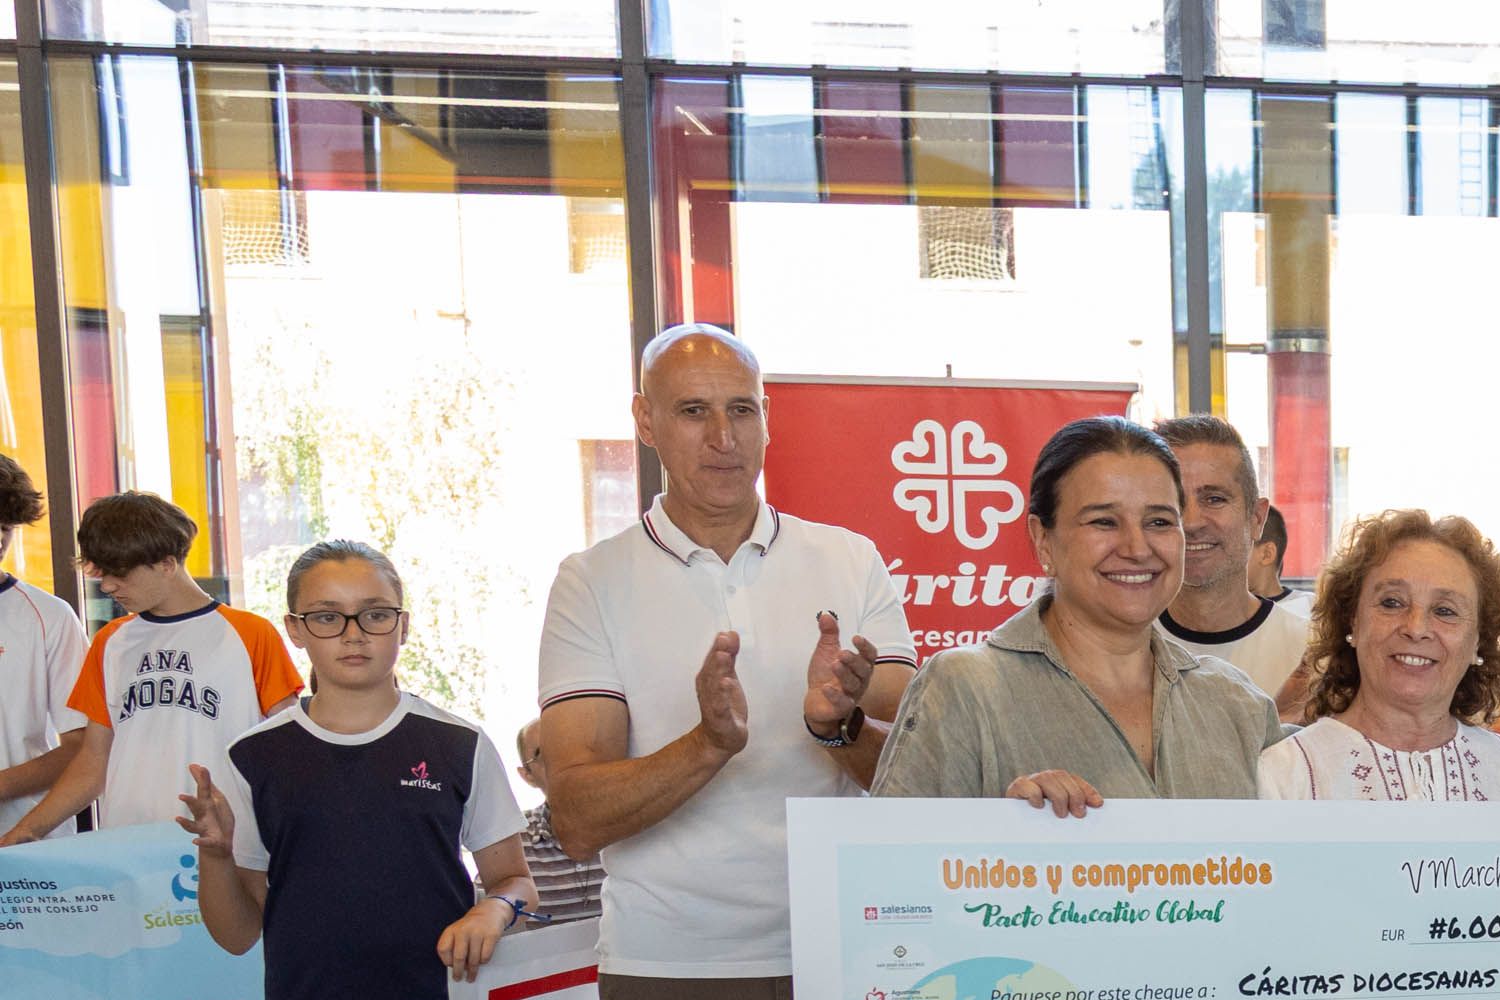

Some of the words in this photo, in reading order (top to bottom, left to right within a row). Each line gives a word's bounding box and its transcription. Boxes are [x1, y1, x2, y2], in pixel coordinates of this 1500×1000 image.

[136, 650, 194, 676] ANA
[118, 679, 222, 722] MOGAS
[942, 858, 1037, 890] Unidos
[1046, 864, 1063, 895] y
[1072, 856, 1273, 892] comprometidos
[1401, 860, 1424, 894] V
[12, 905, 42, 915] BUEN
[46, 904, 99, 914] CONSEJO
[37, 895, 71, 905] NTRA.
[75, 893, 117, 903] MADRE
[880, 904, 933, 915] salesianos
[963, 902, 1043, 928] Pacto
[1048, 899, 1151, 924] Educativo
[1156, 898, 1225, 923] Global
[1382, 928, 1405, 942] EUR
[1238, 966, 1344, 996] CÁRITAS
[1353, 968, 1499, 993] DIOCESANAS
